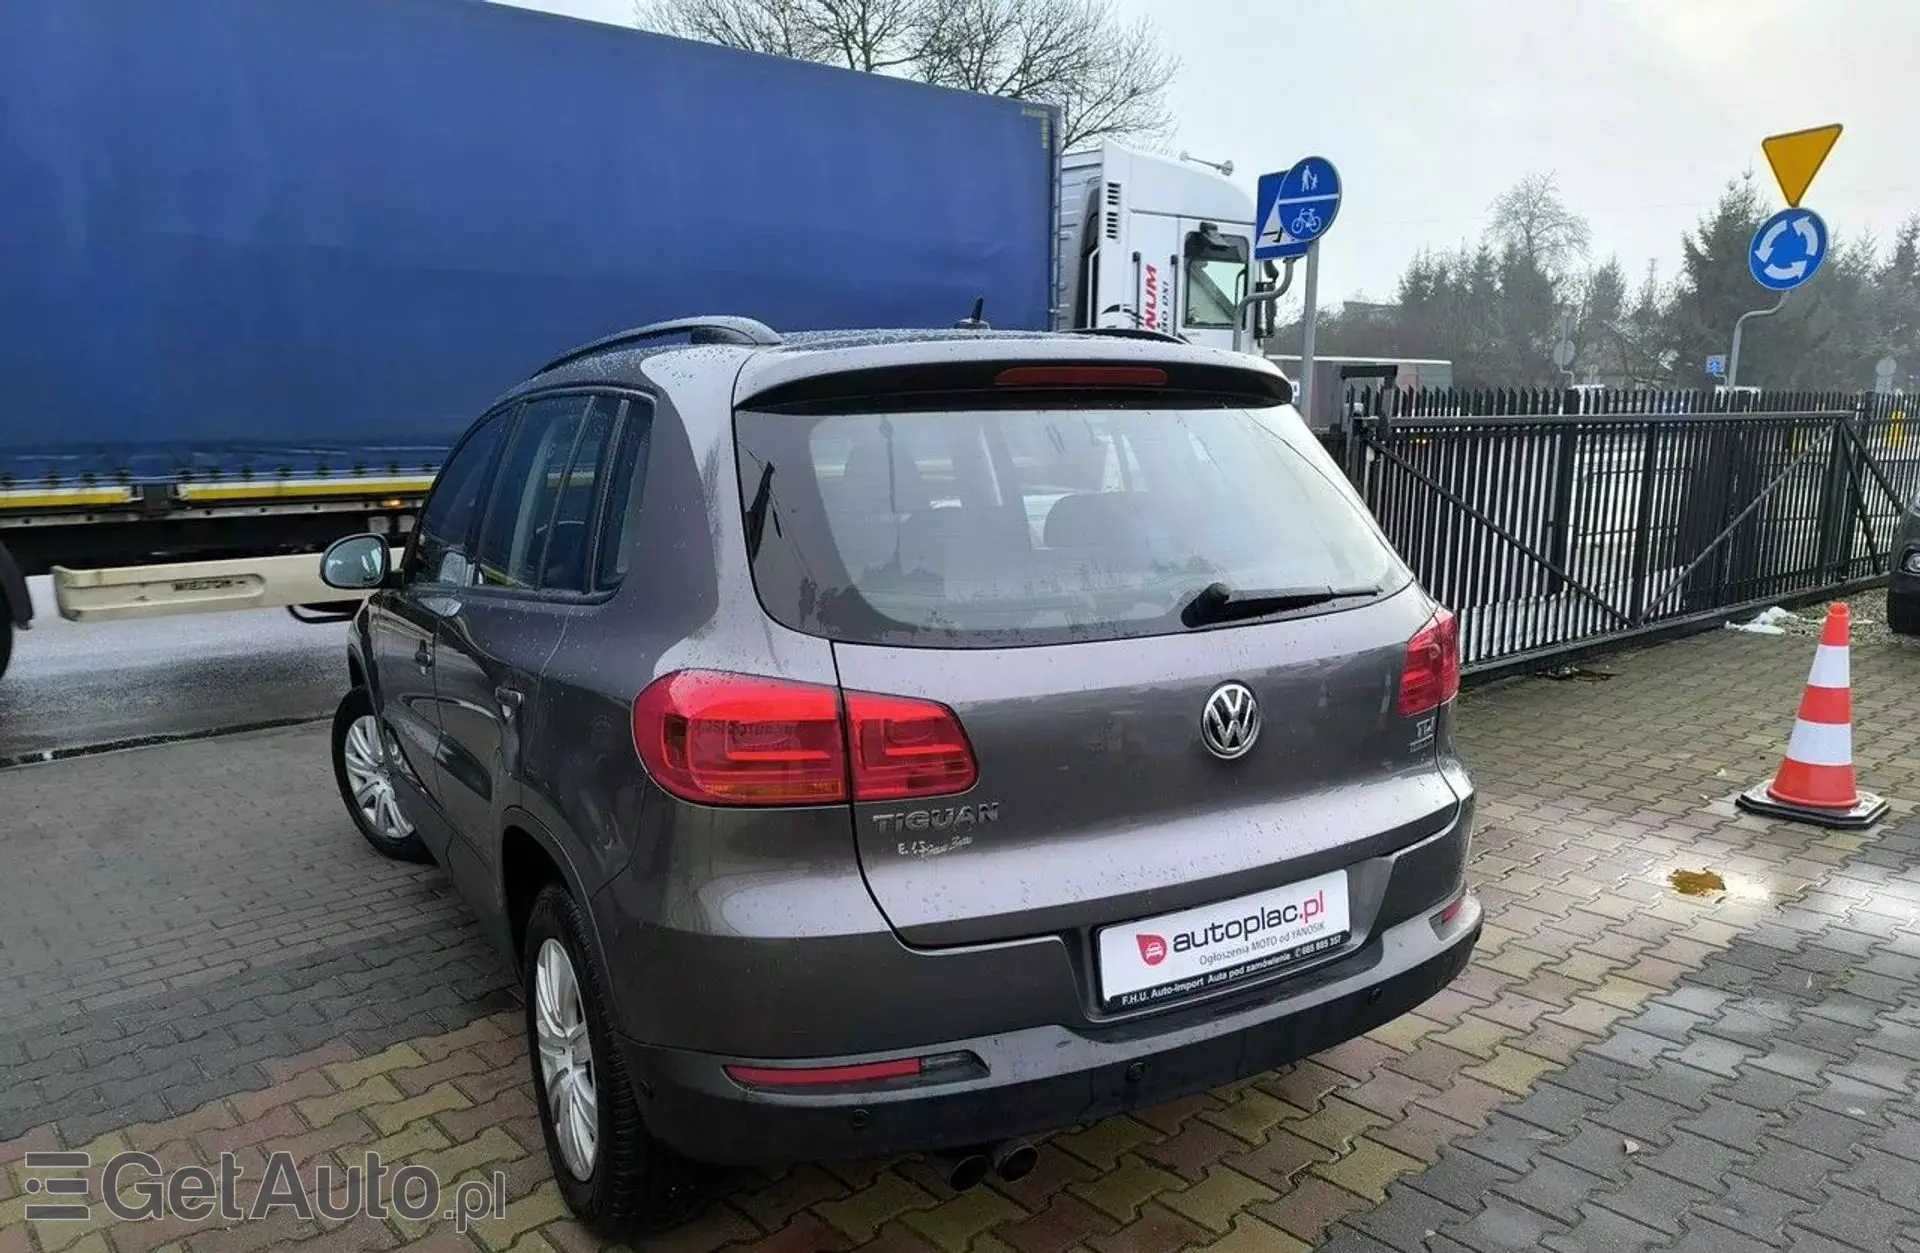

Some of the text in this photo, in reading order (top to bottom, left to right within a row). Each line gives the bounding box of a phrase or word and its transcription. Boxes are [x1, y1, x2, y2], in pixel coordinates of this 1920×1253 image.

[872, 802, 1000, 833] TIGUAN
[1172, 890, 1325, 953] autoplac.pl
[1251, 936, 1278, 951] MOTO
[1279, 931, 1290, 943] od
[1121, 992, 1150, 1006] F.H.U.
[1207, 970, 1228, 984] Auta
[1228, 965, 1245, 979] pod
